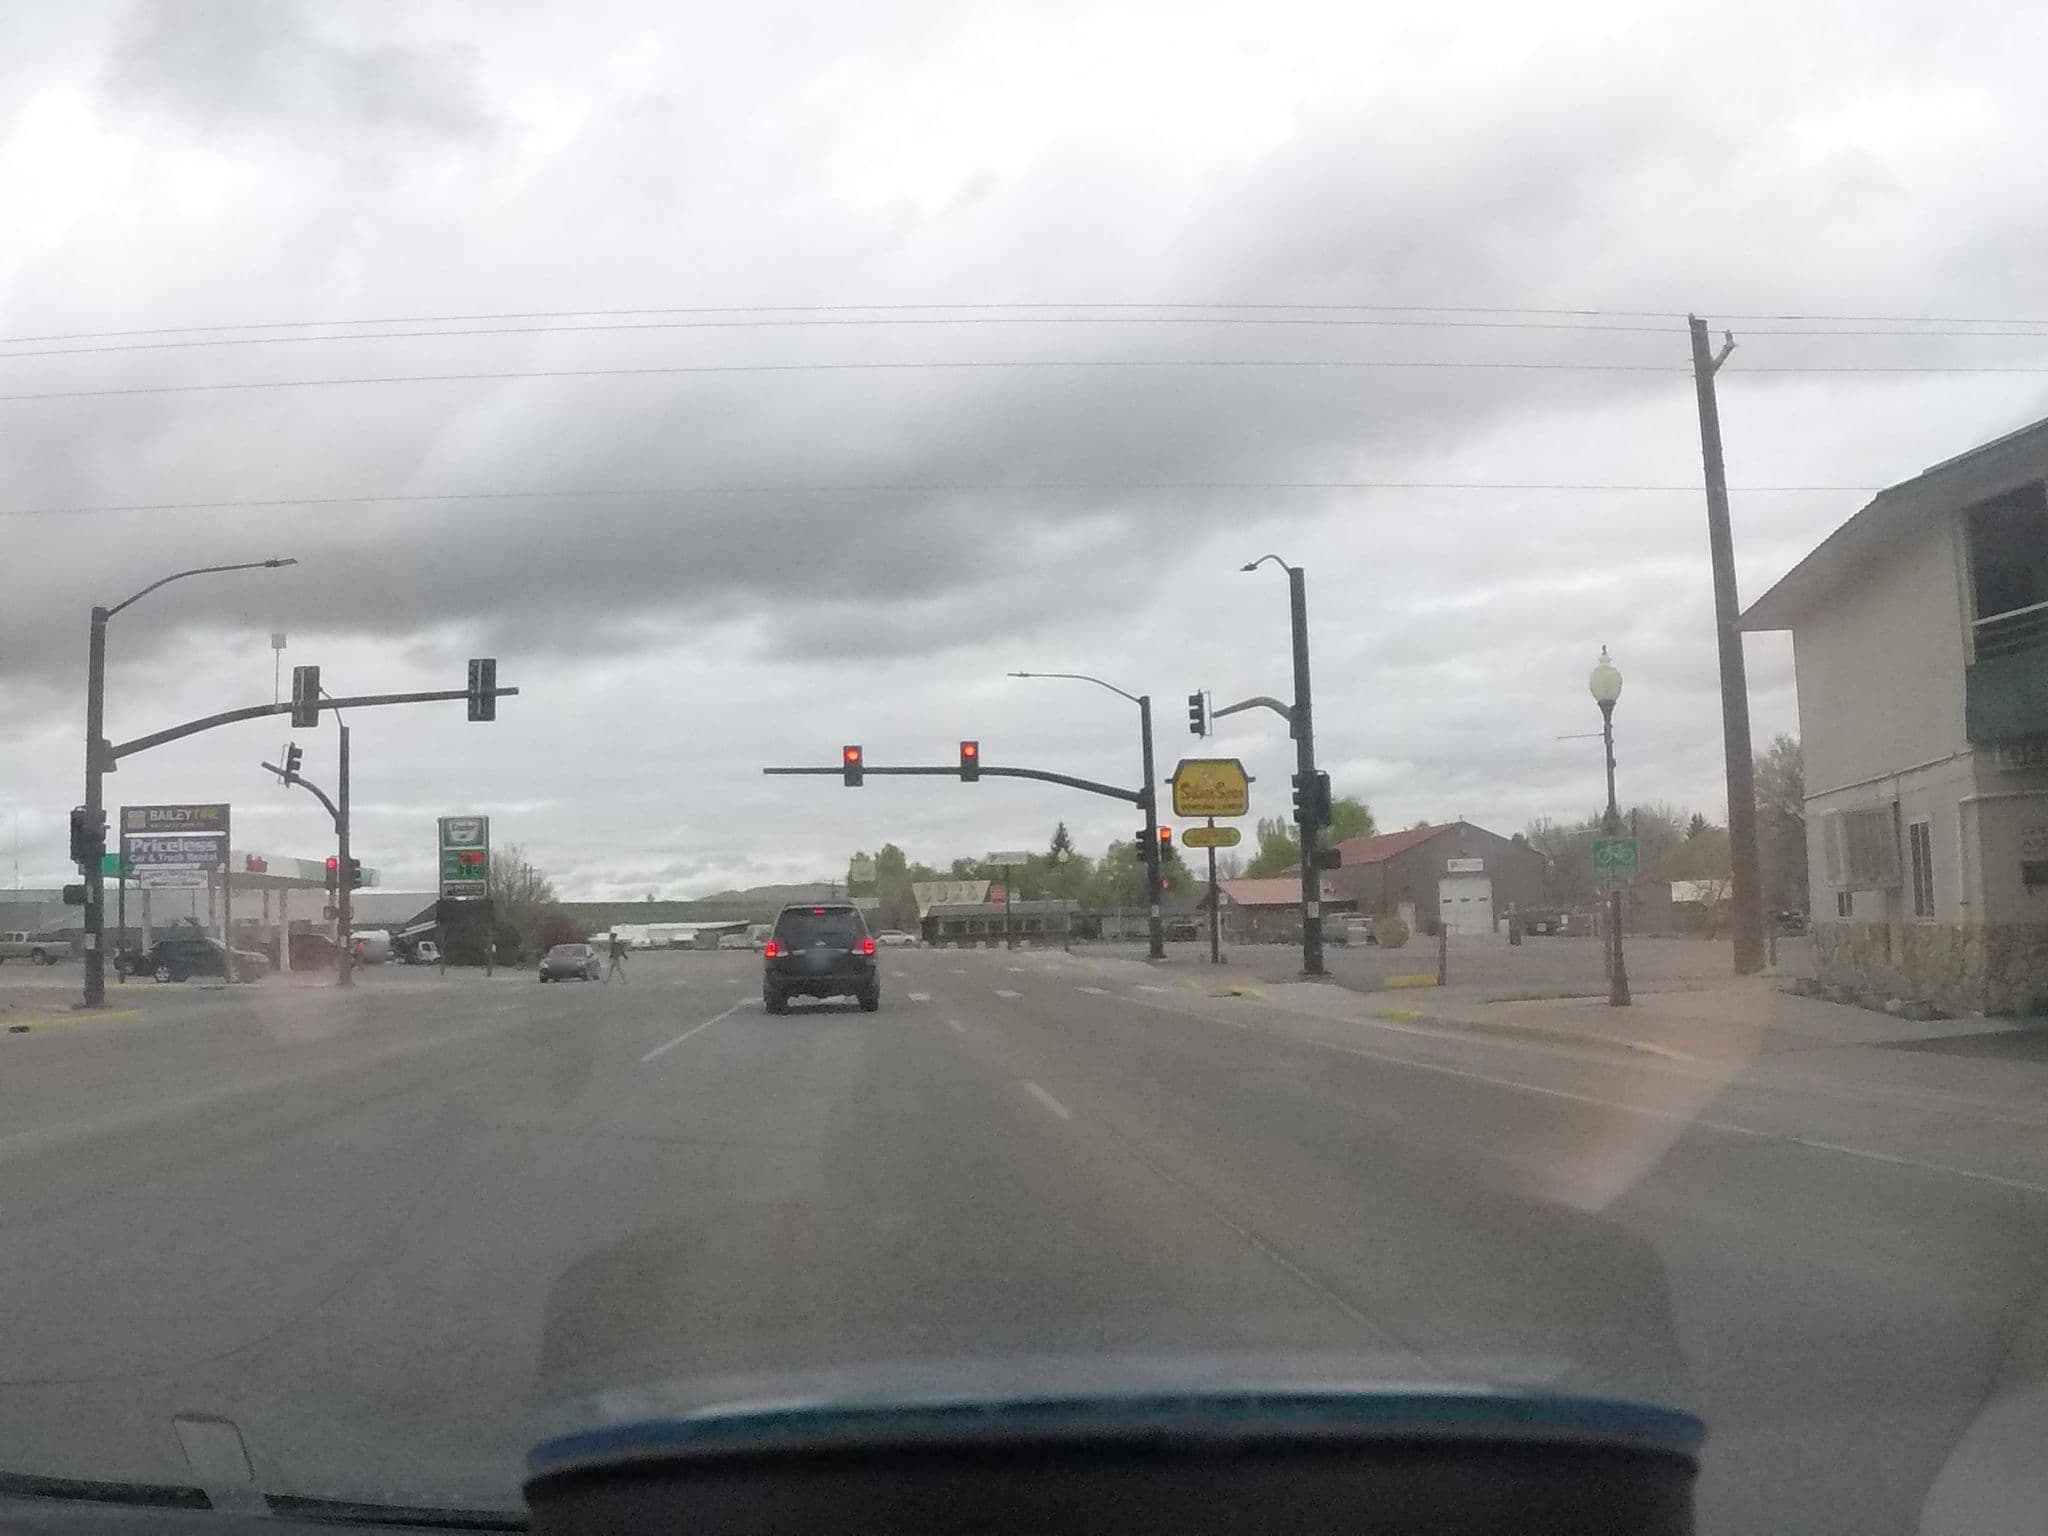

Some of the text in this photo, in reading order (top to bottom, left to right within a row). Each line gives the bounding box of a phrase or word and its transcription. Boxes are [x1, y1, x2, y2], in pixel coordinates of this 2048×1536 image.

[150, 809, 193, 821] BAILEY
[130, 838, 217, 852] Priceless
[129, 852, 218, 863] Car & Truck Rental
